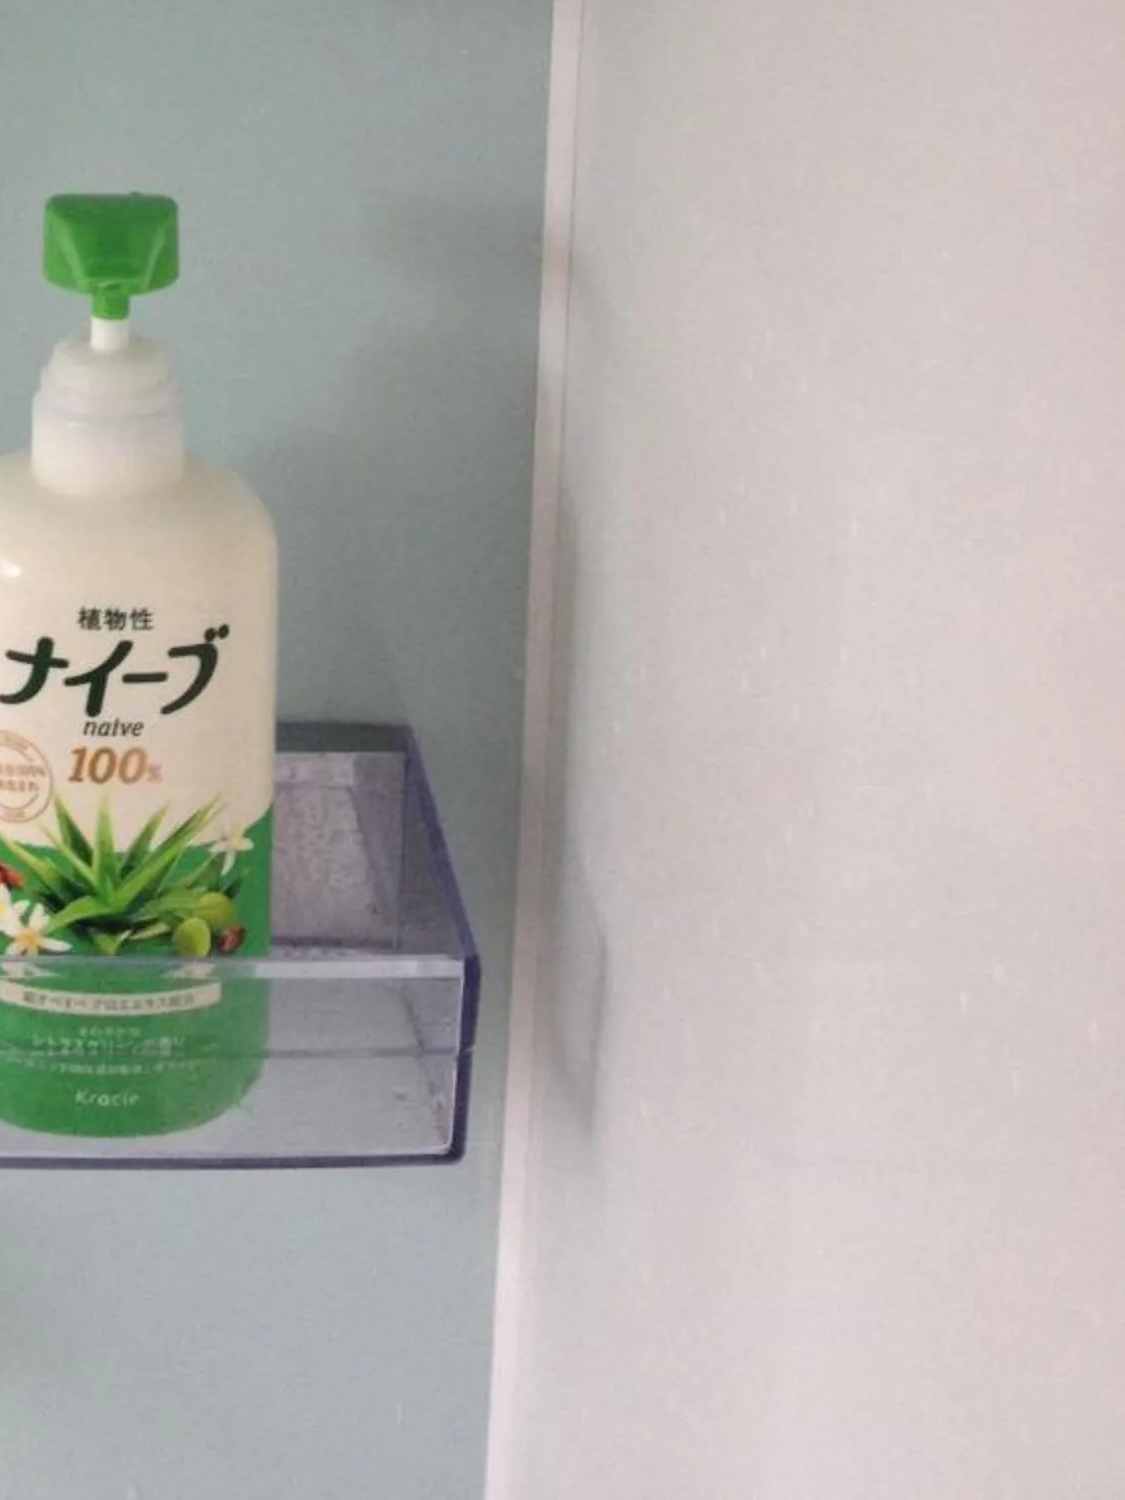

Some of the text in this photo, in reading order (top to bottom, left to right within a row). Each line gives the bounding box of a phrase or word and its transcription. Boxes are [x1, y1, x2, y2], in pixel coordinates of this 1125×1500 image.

[77, 606, 154, 631] 植物性
[74, 1089, 140, 1107] Kracie
